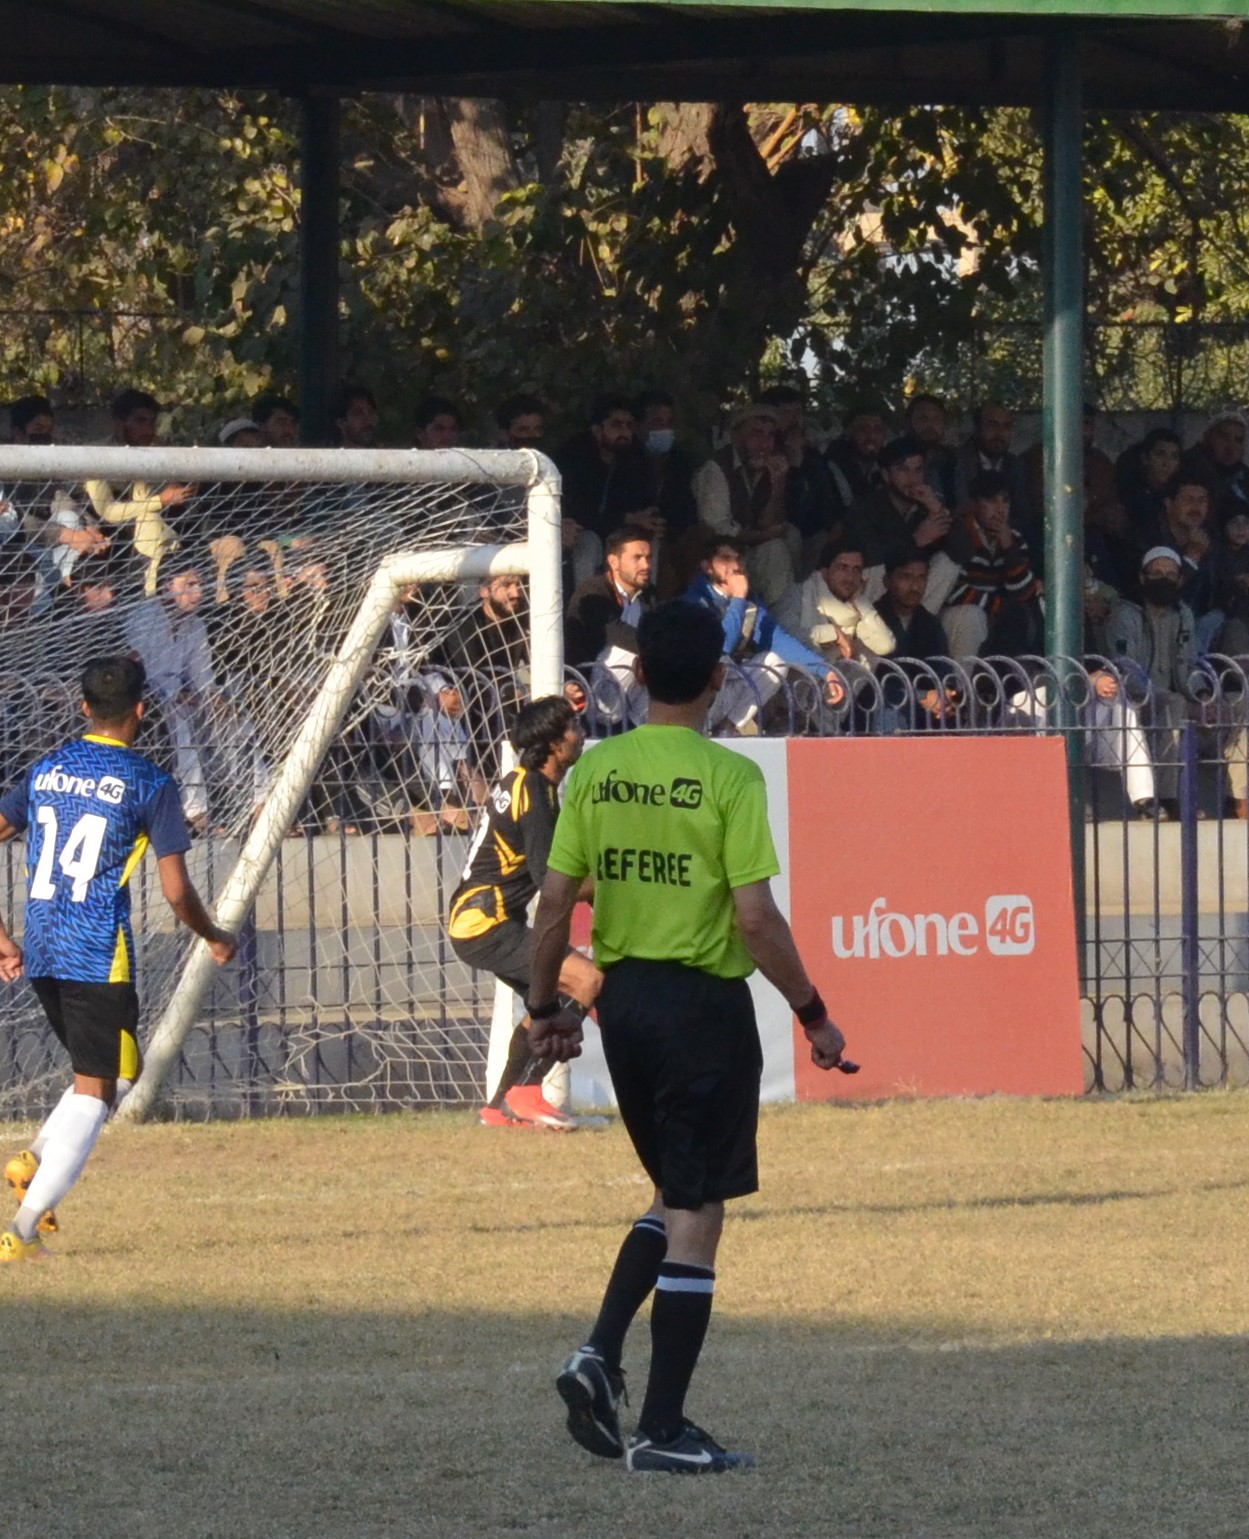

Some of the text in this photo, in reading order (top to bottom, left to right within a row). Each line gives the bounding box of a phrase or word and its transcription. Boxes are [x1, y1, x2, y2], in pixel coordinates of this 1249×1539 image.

[34, 765, 124, 801] ufone 4G
[591, 769, 702, 807] ufone 4G
[30, 806, 107, 902] 14
[831, 897, 1033, 959] ufone 4G
